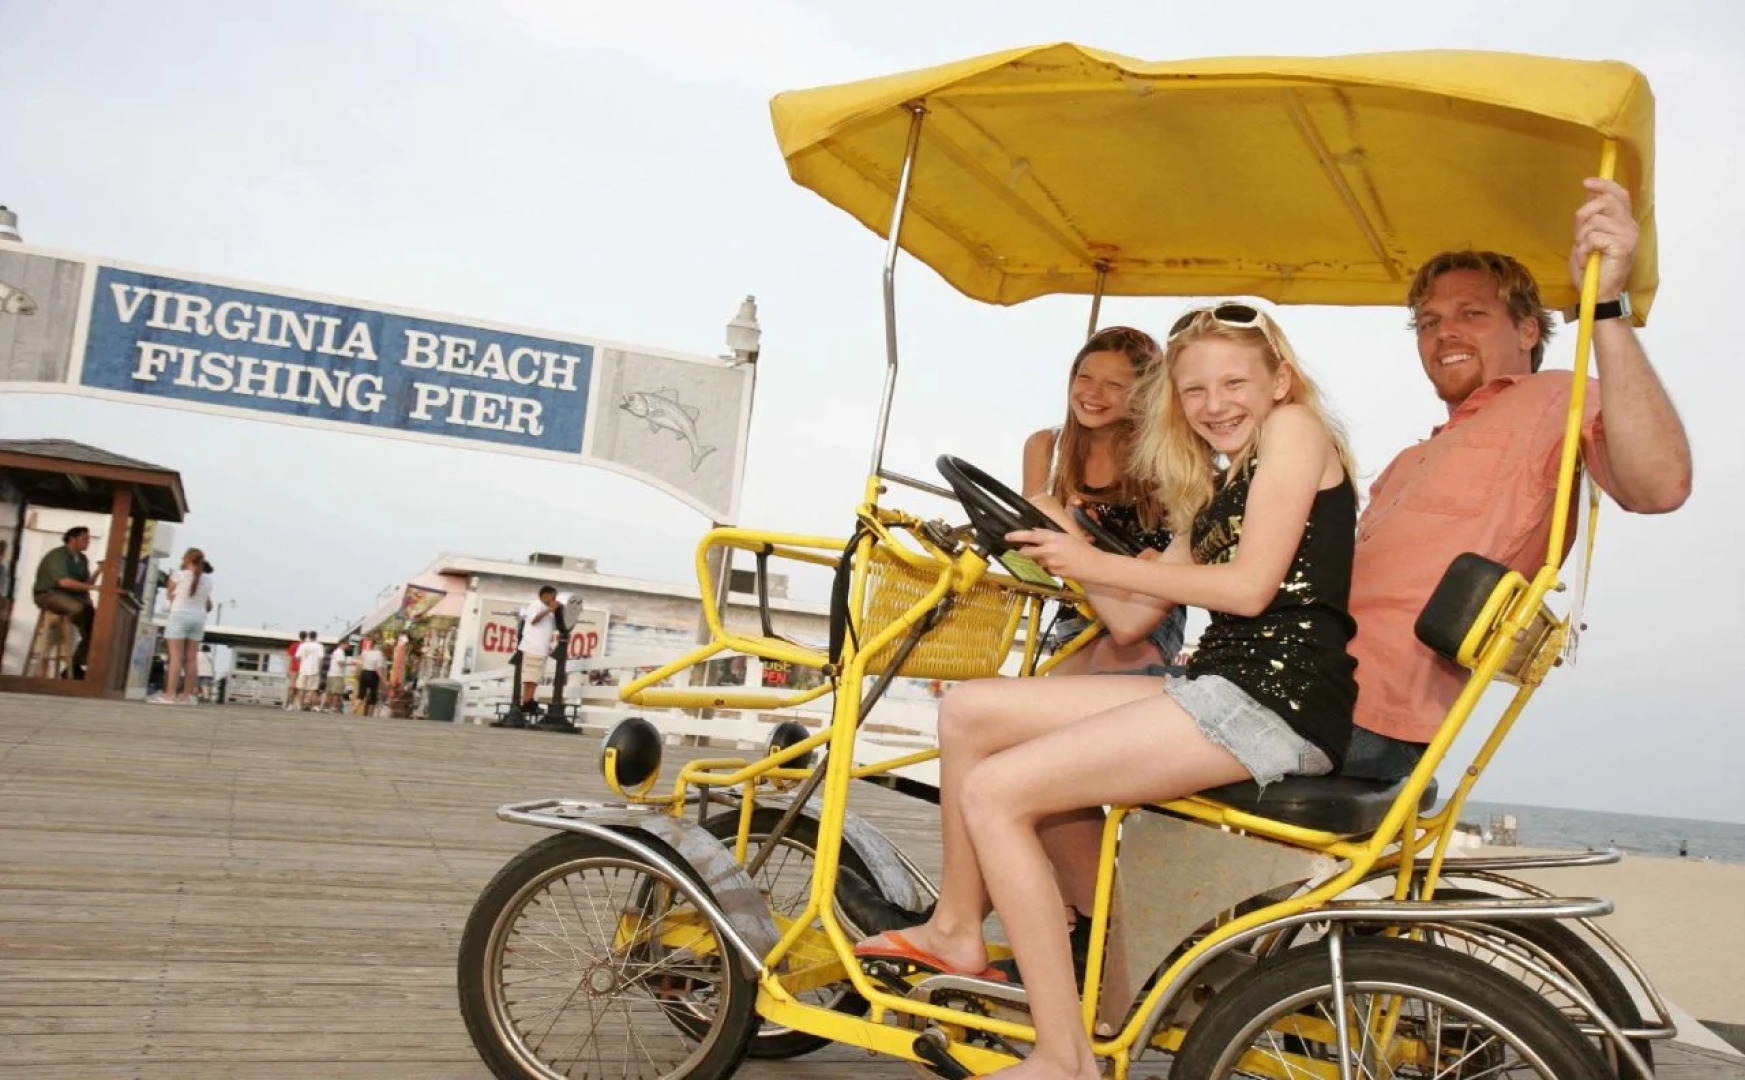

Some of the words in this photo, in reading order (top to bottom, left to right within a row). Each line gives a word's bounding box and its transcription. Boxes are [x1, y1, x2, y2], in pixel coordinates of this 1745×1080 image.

[110, 282, 378, 362] VIRGINIA
[401, 329, 581, 392] BEACH
[132, 340, 386, 413] FISHING
[409, 382, 545, 437] PIER
[483, 622, 518, 653] GIF
[763, 671, 786, 684] PEN
